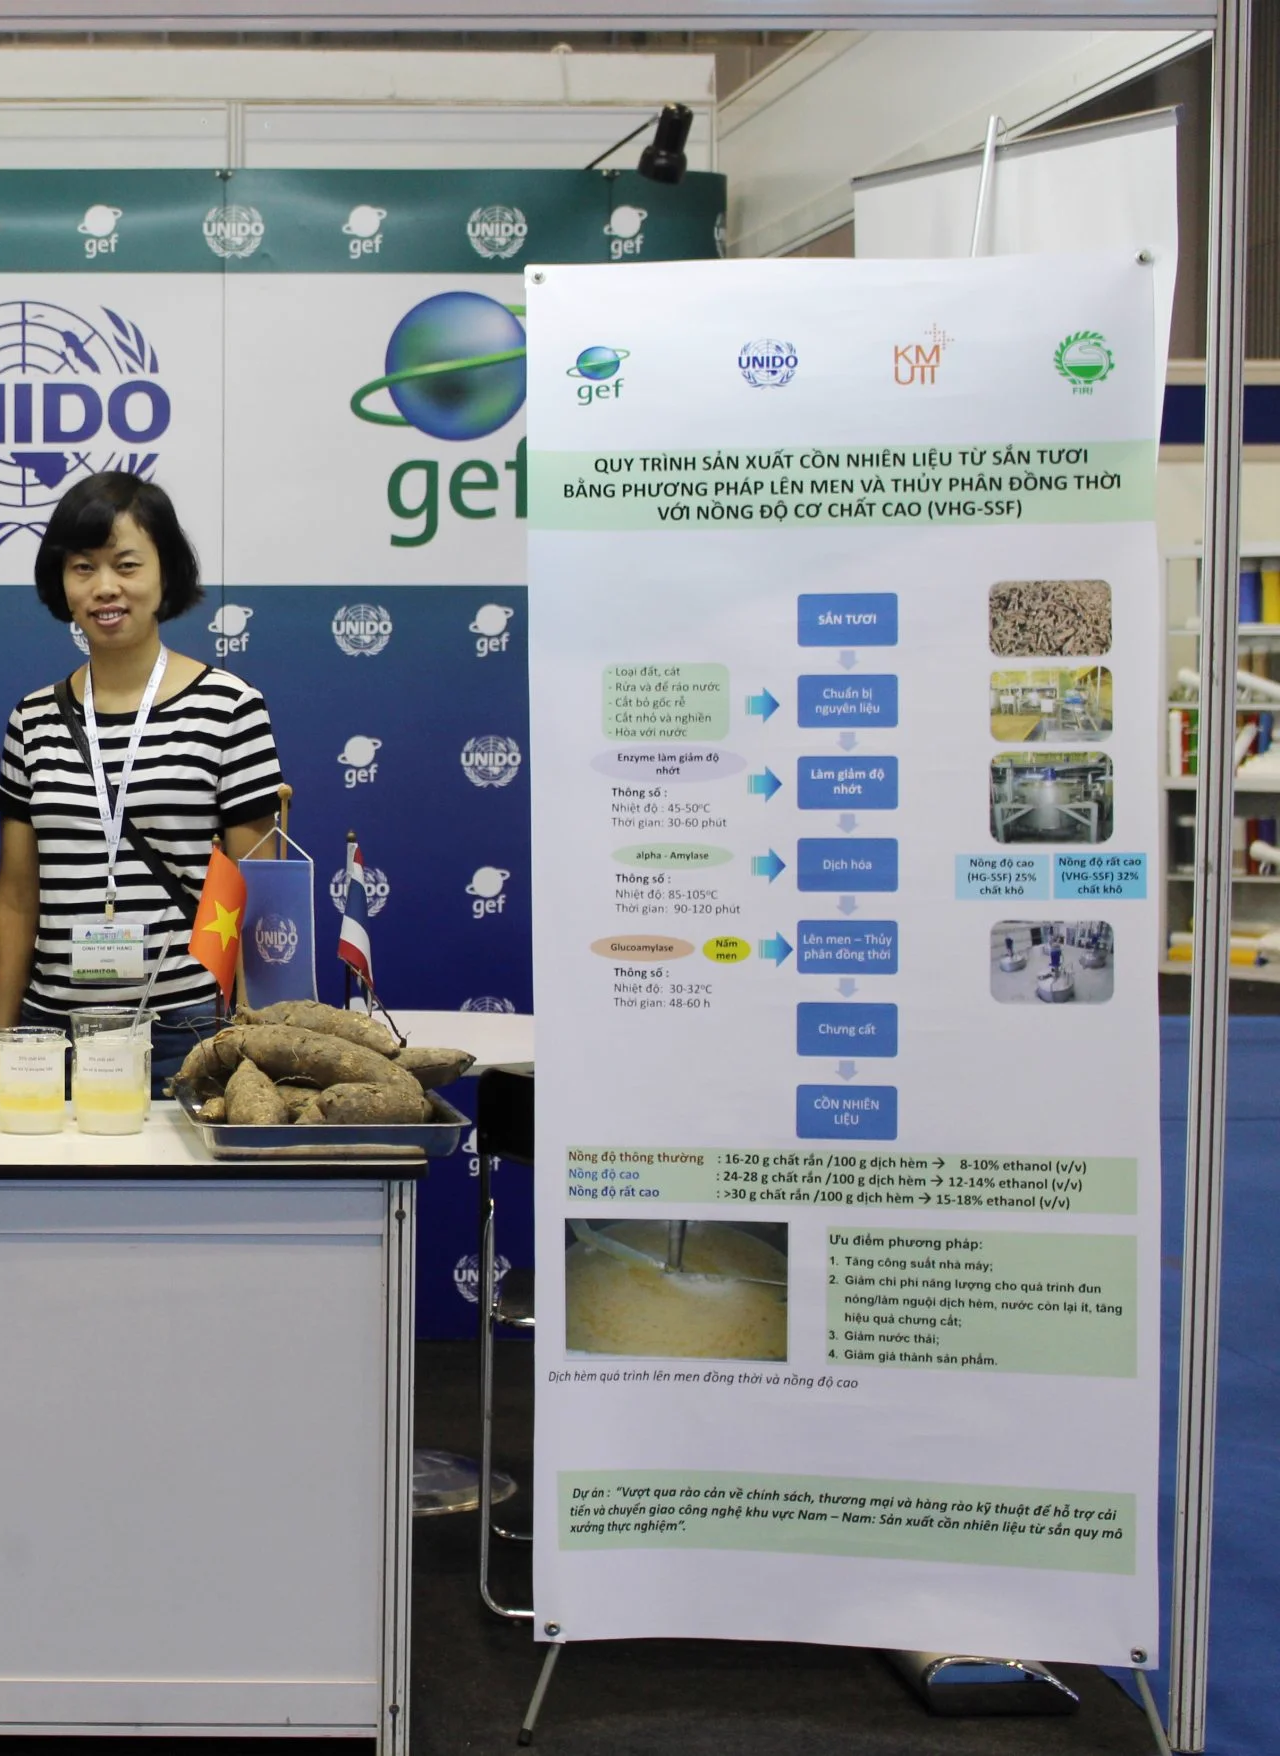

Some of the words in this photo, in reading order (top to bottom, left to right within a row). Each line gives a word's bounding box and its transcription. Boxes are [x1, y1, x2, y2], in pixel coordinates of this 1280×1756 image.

[203, 222, 264, 238] UNIDO
[467, 222, 528, 238] UNIDO
[85, 234, 118, 258] gef
[349, 234, 383, 259] gef
[611, 235, 644, 259] gef
[738, 354, 798, 370] UNIDO
[893, 344, 941, 364] KM
[577, 378, 625, 406] gef
[594, 458, 634, 473] QUY
[640, 454, 695, 471] TRÌNH
[702, 451, 738, 470] SẢN
[746, 450, 793, 469] XUẤT
[800, 449, 839, 468] CỒN
[847, 449, 905, 467] NHIÊN
[913, 449, 951, 469] LIỆU
[959, 448, 986, 465] TỪ
[992, 445, 1030, 465] SẮN
[1037, 449, 1087, 464] TƯƠI
[564, 480, 615, 497] BẰNG
[622, 482, 707, 497] PHƯƠNG
[714, 478, 764, 495] PHÁP
[770, 476, 803, 494] LÊN
[810, 480, 853, 493] MEN
[860, 475, 885, 492] VÀ
[891, 473, 942, 492] THỦY
[949, 474, 1001, 491] PHÂN
[1009, 471, 1067, 490] ĐỒNG
[1073, 472, 1120, 489] THỜI
[657, 503, 689, 520] VỚI
[697, 500, 752, 519] NỒNG
[759, 500, 787, 521] ĐỘ
[794, 502, 822, 518] CƠ
[828, 498, 876, 517] CHẤT
[882, 502, 921, 516] CAO
[928, 500, 1021, 518] (VHG-SSF)
[332, 620, 392, 636] UNIDO
[215, 633, 250, 657] gef
[476, 633, 509, 657] gef
[815, 702, 856, 716] nguyên
[860, 703, 880, 715] liệu
[460, 752, 521, 767] UNIDO
[344, 764, 378, 788] gef
[823, 859, 847, 870] Dịch
[851, 860, 872, 869] hóa
[473, 895, 506, 919] gef
[255, 930, 299, 945] UNIDO
[610, 943, 673, 952] Glucoamylase
[826, 936, 851, 944] men
[843, 1097, 879, 1110] NHIÊN
